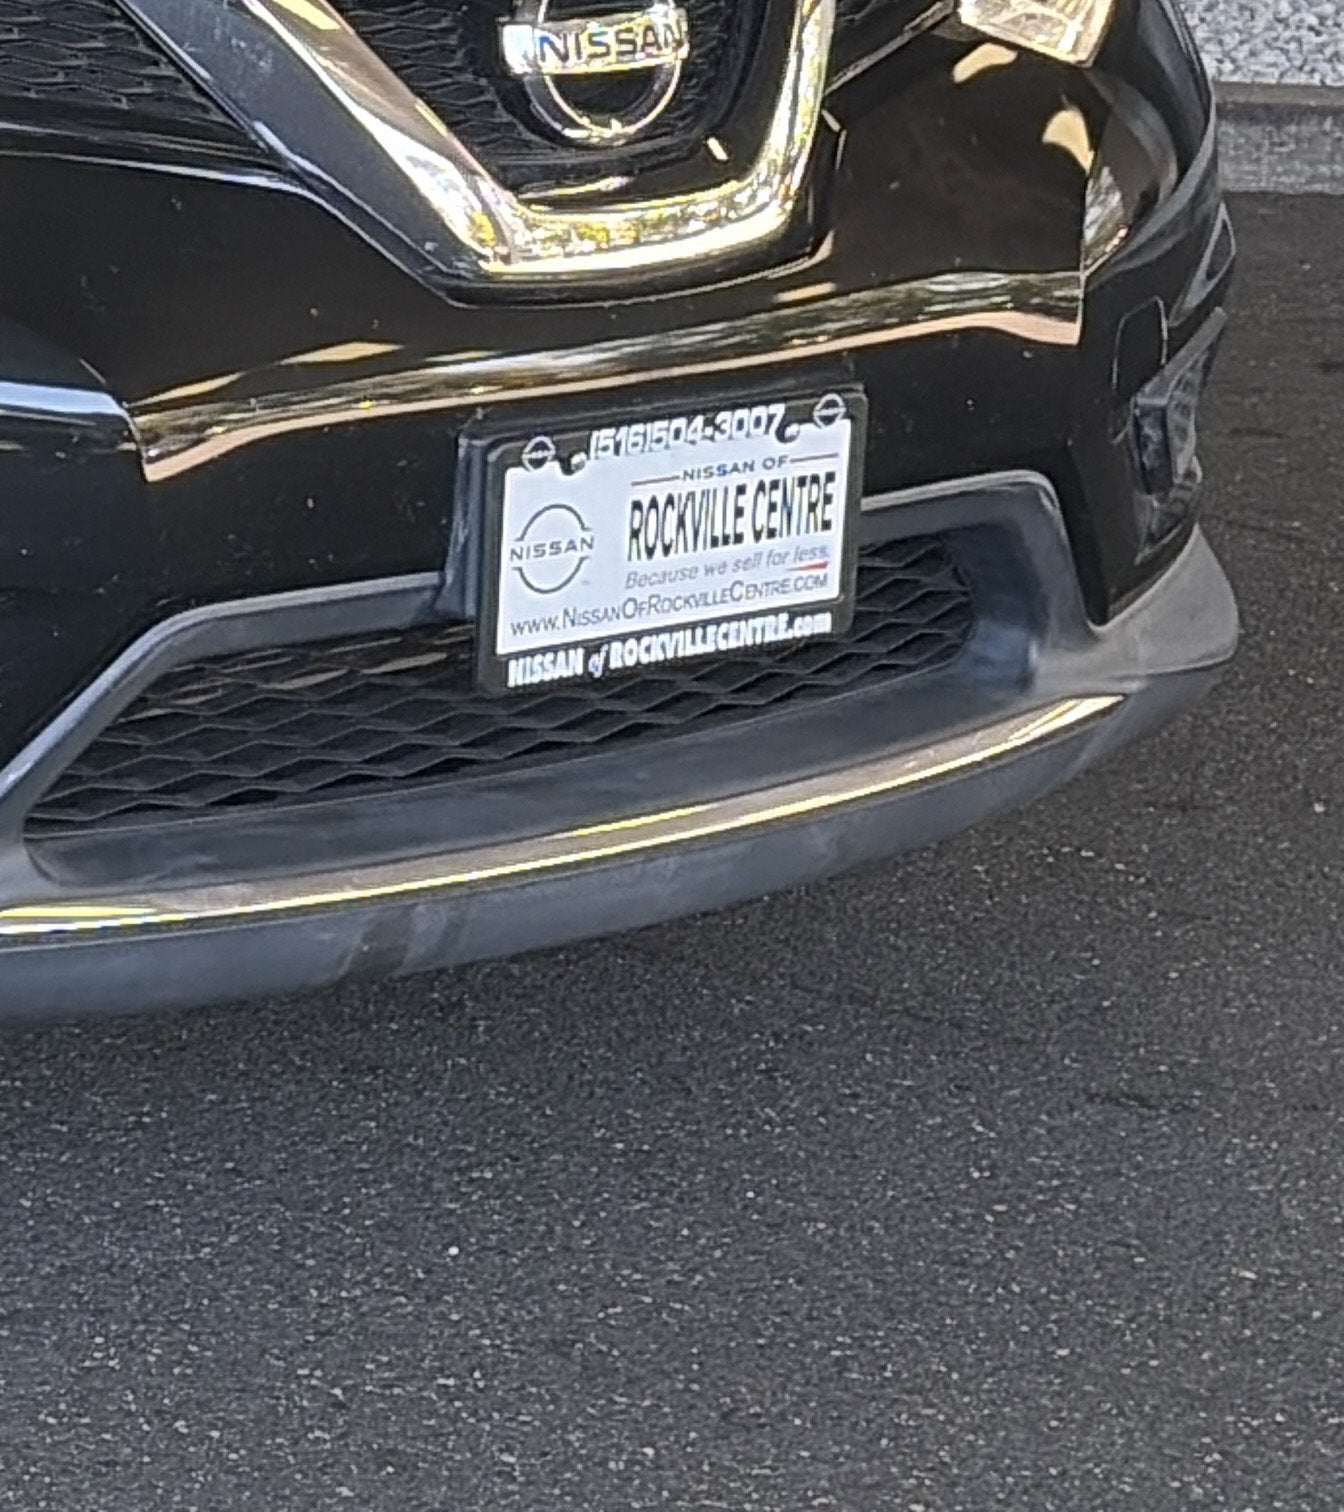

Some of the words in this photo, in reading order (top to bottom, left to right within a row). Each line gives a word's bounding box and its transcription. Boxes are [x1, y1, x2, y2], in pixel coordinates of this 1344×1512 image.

[539, 20, 687, 65] NISSAN
[681, 459, 755, 482] NISSAN
[762, 455, 790, 472] OF
[627, 482, 747, 562] ROCKVILLE
[752, 471, 836, 544] CENTRE
[510, 536, 596, 562] NISSAN
[625, 566, 699, 590] Because
[704, 561, 728, 576] we
[732, 552, 764, 573] sell
[766, 548, 791, 568] for
[507, 646, 585, 688] NISSAN
